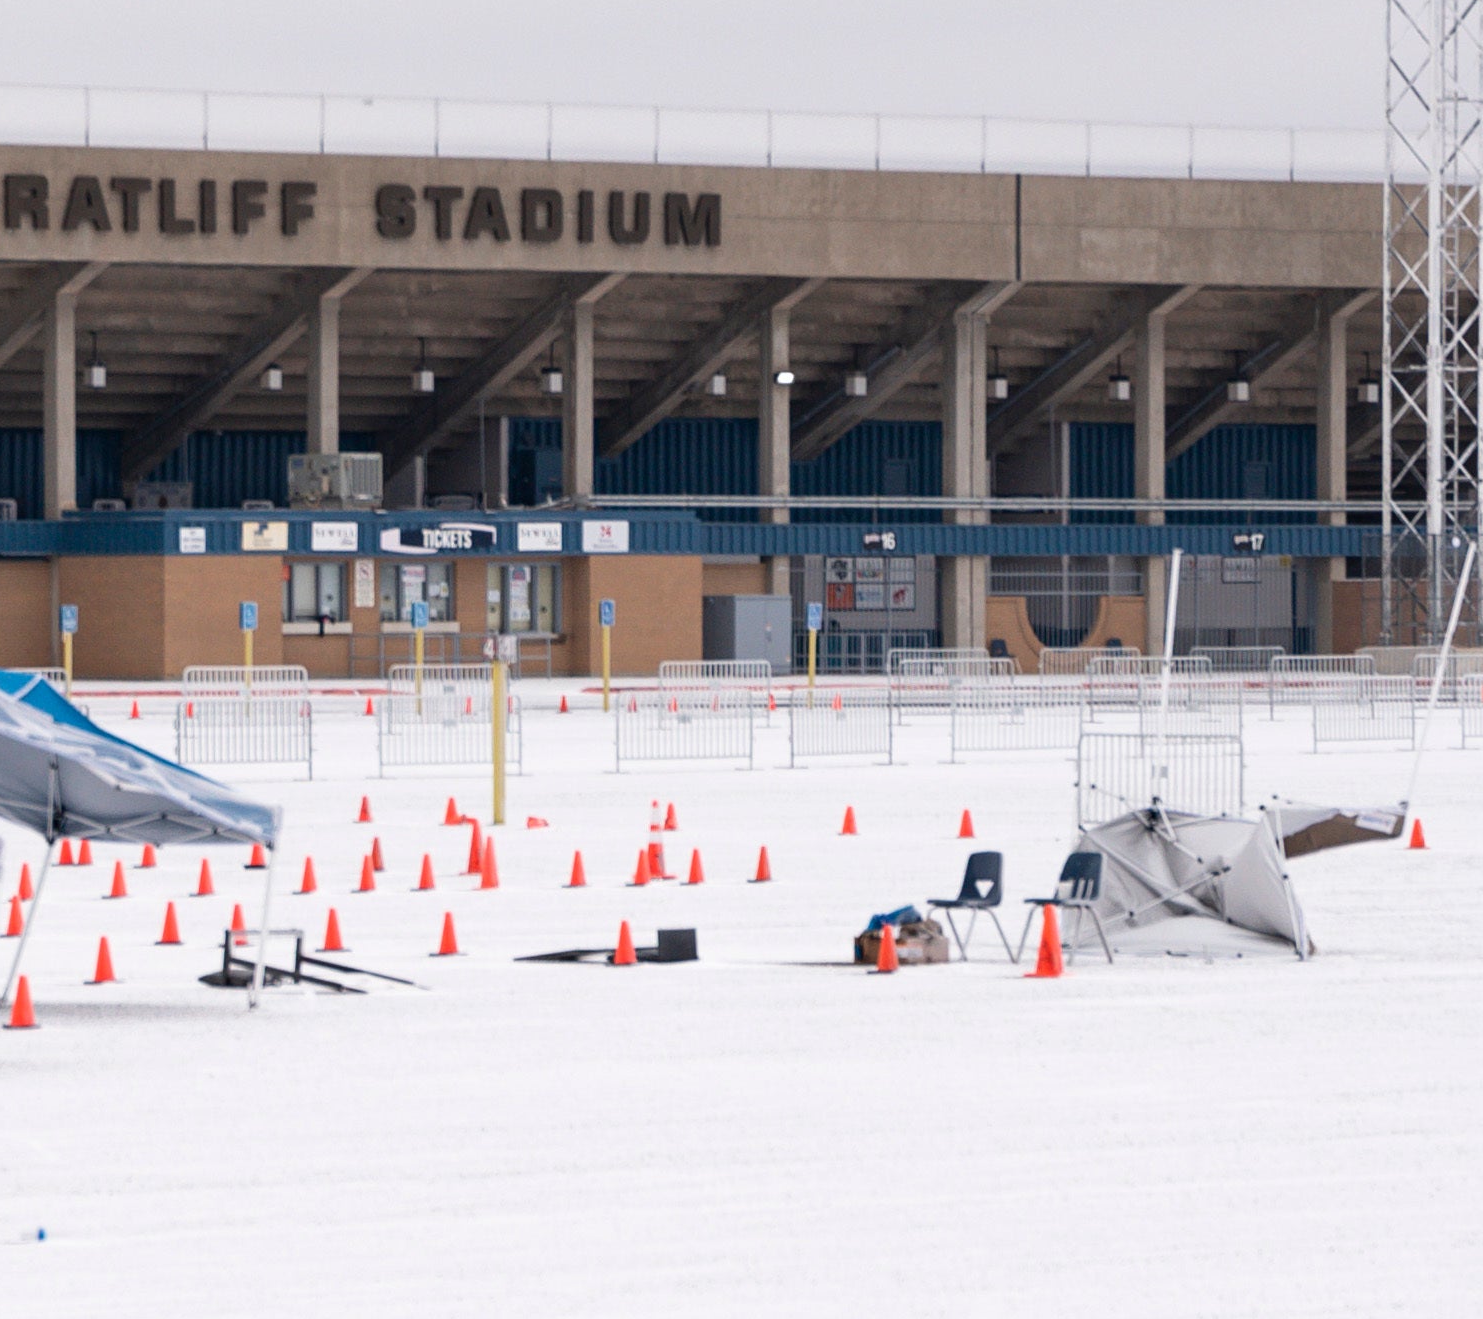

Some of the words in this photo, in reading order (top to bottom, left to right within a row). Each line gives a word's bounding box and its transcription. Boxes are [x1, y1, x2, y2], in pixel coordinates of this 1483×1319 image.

[3, 174, 317, 236] RATLIFF
[375, 184, 721, 247] STADIUM
[422, 529, 472, 548] TICKETS
[881, 532, 896, 549] 16
[1250, 534, 1264, 550] 17
[483, 639, 494, 659] 4
